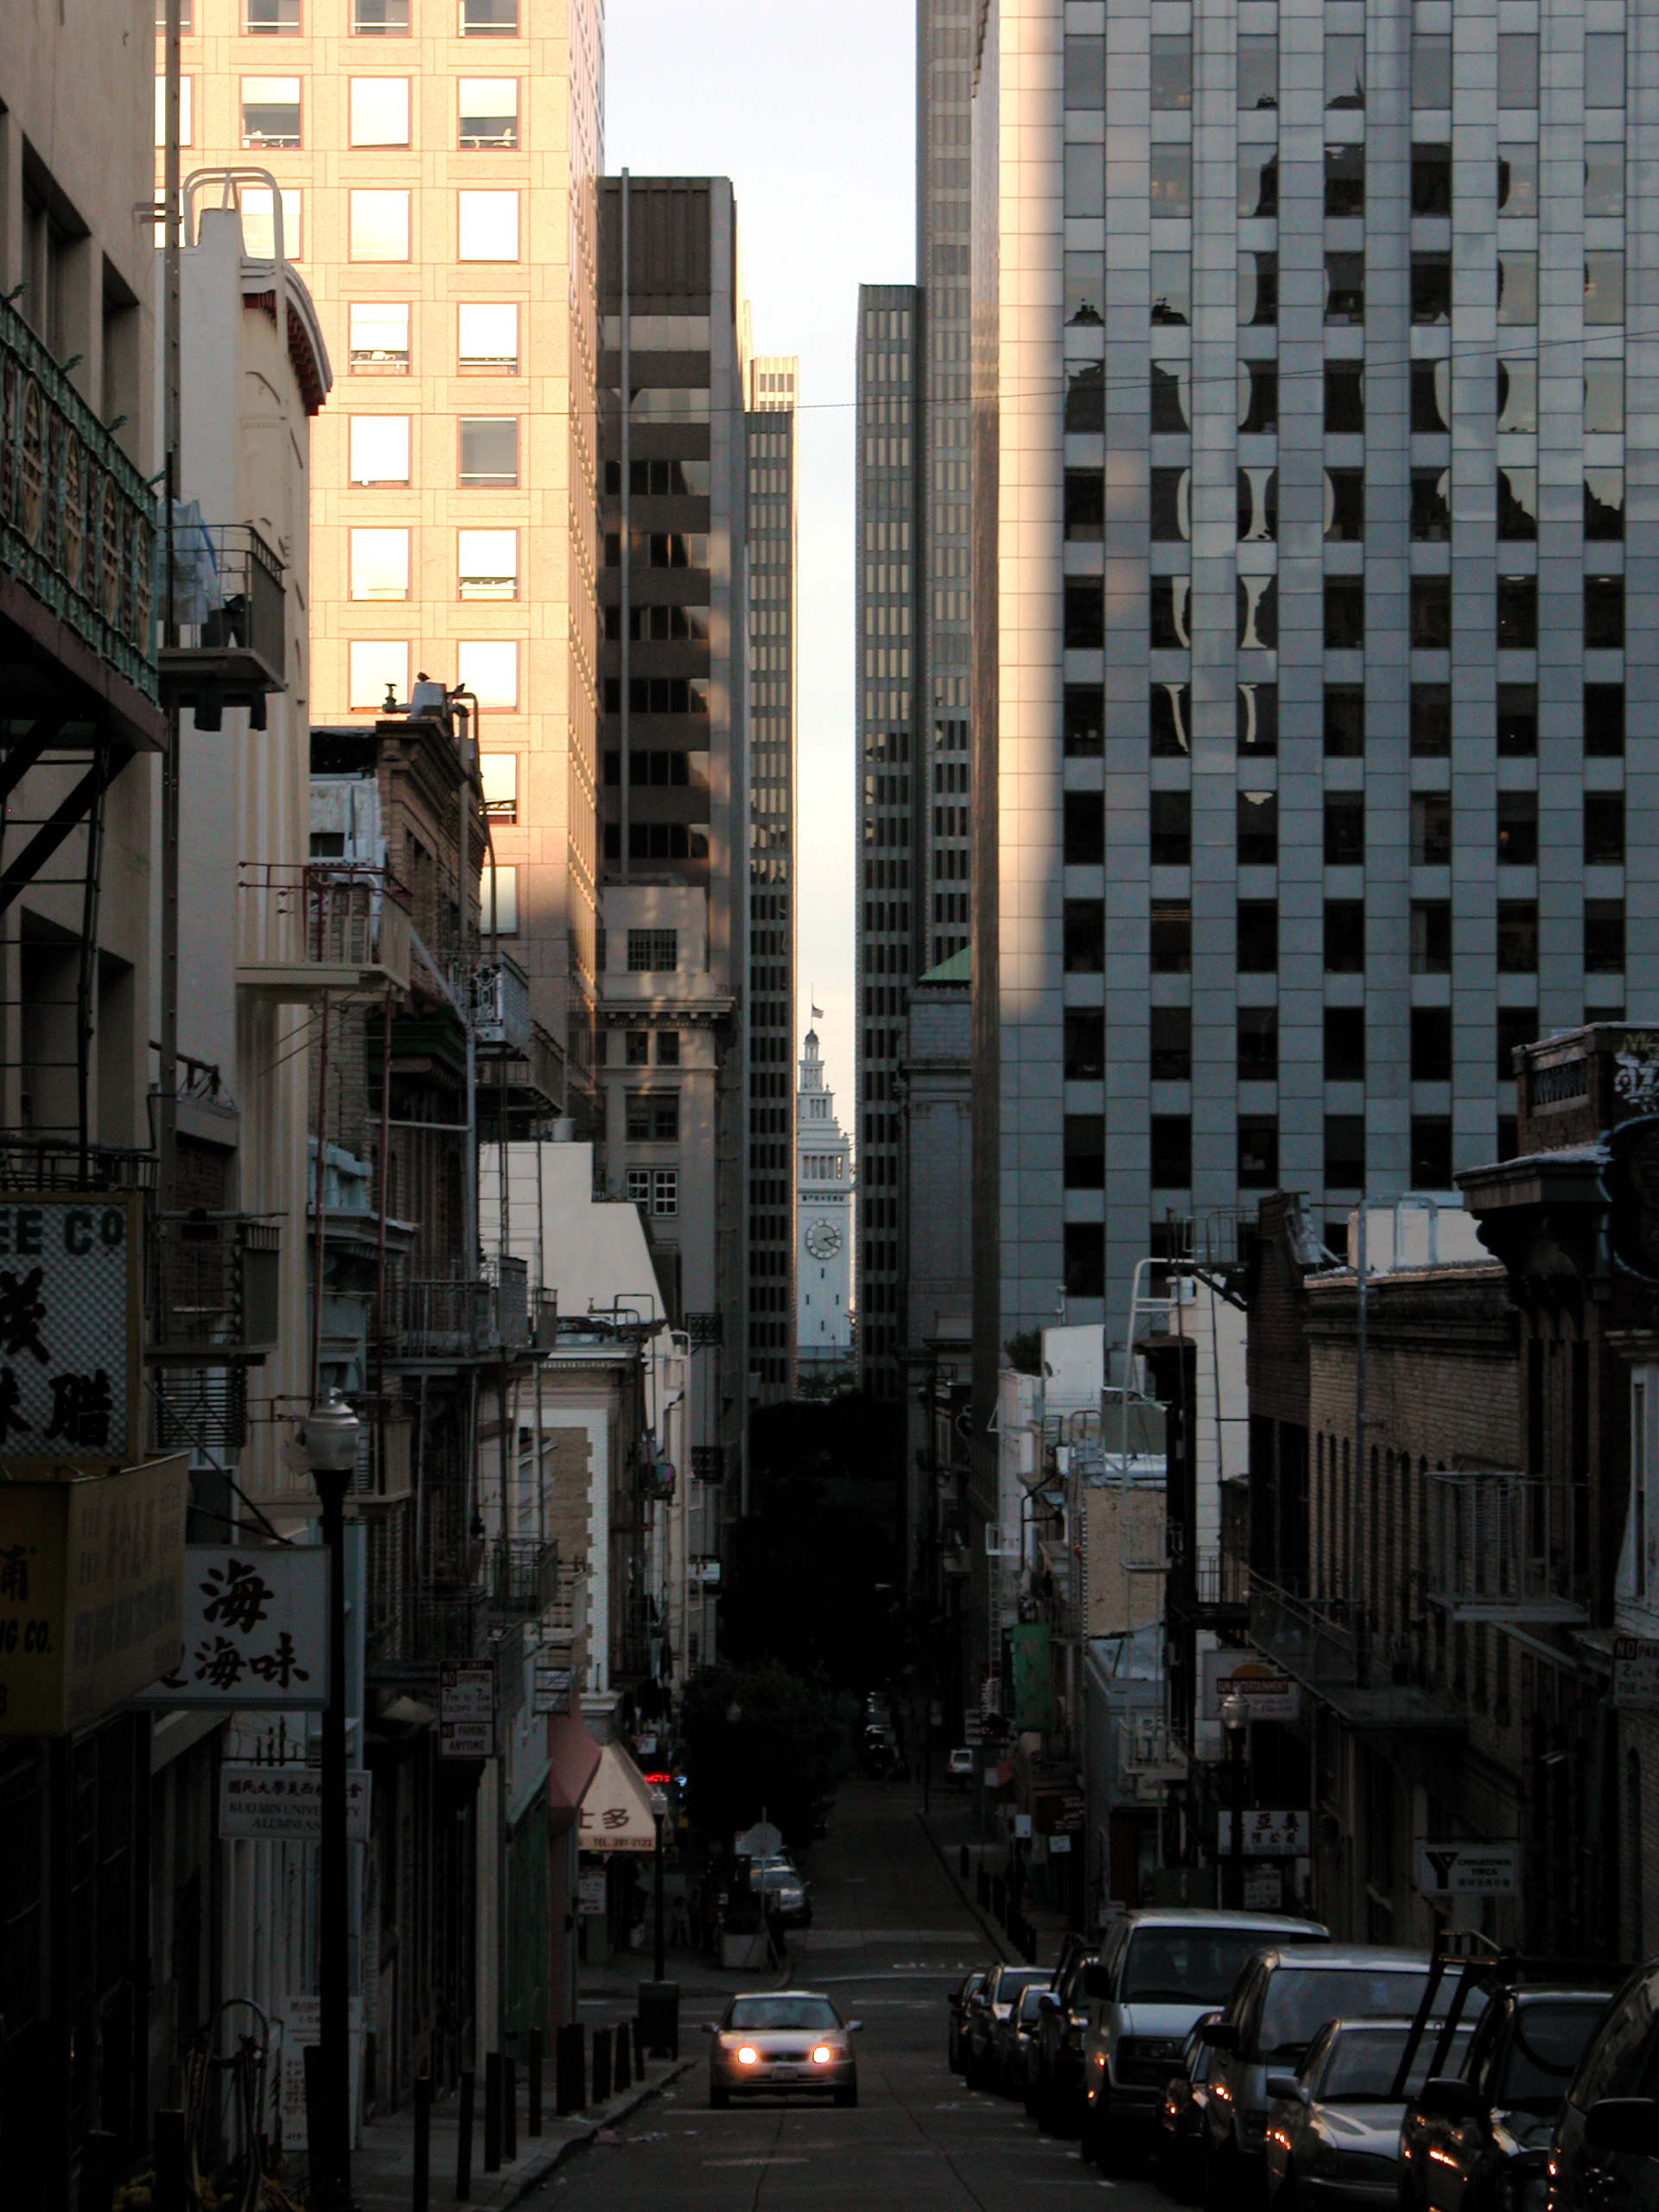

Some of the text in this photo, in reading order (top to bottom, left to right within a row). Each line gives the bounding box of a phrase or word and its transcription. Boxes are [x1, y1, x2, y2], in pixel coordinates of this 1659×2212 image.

[200, 1559, 274, 1633] 海
[24, 1621, 52, 1654] CO.
[1616, 1640, 1635, 1659] NO
[442, 1672, 455, 1686] NO
[1619, 1681, 1637, 1694] TUE
[450, 1741, 485, 1751] ANYTIME
